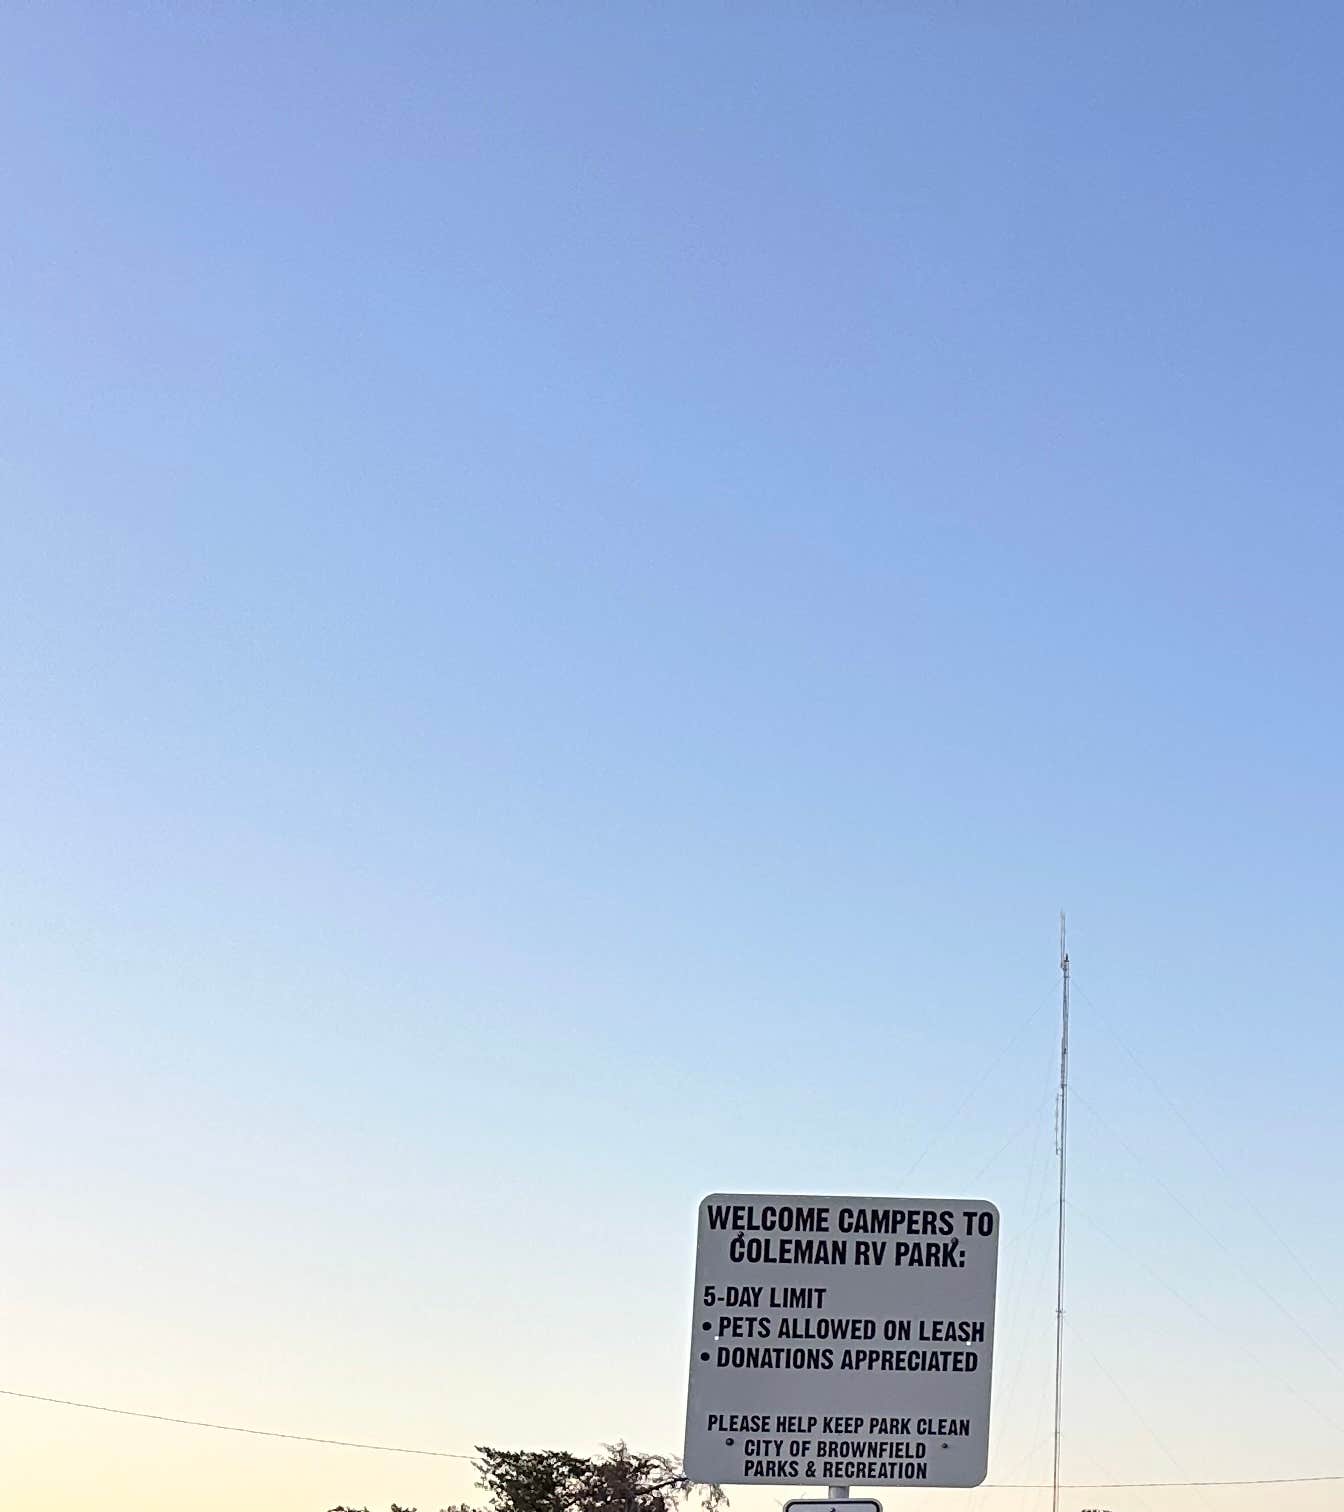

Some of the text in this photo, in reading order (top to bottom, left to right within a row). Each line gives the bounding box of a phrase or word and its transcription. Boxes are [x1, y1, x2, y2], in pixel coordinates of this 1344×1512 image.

[707, 1205, 993, 1236] WELCOME CAMPERS TO
[729, 1238, 966, 1268] COLEMAN RV PARK:
[703, 1285, 827, 1309] 5-DAY LIMIT
[719, 1316, 985, 1343] PETS ALLOWED ON LEASH
[717, 1346, 979, 1373] DONATIONS APPRECIATED
[707, 1414, 970, 1436] PLEASE HELP KEEP PARK CLEAN
[744, 1439, 926, 1459] CITY OF BROWNFIELD
[744, 1460, 928, 1479] PARKS & RECREATION
